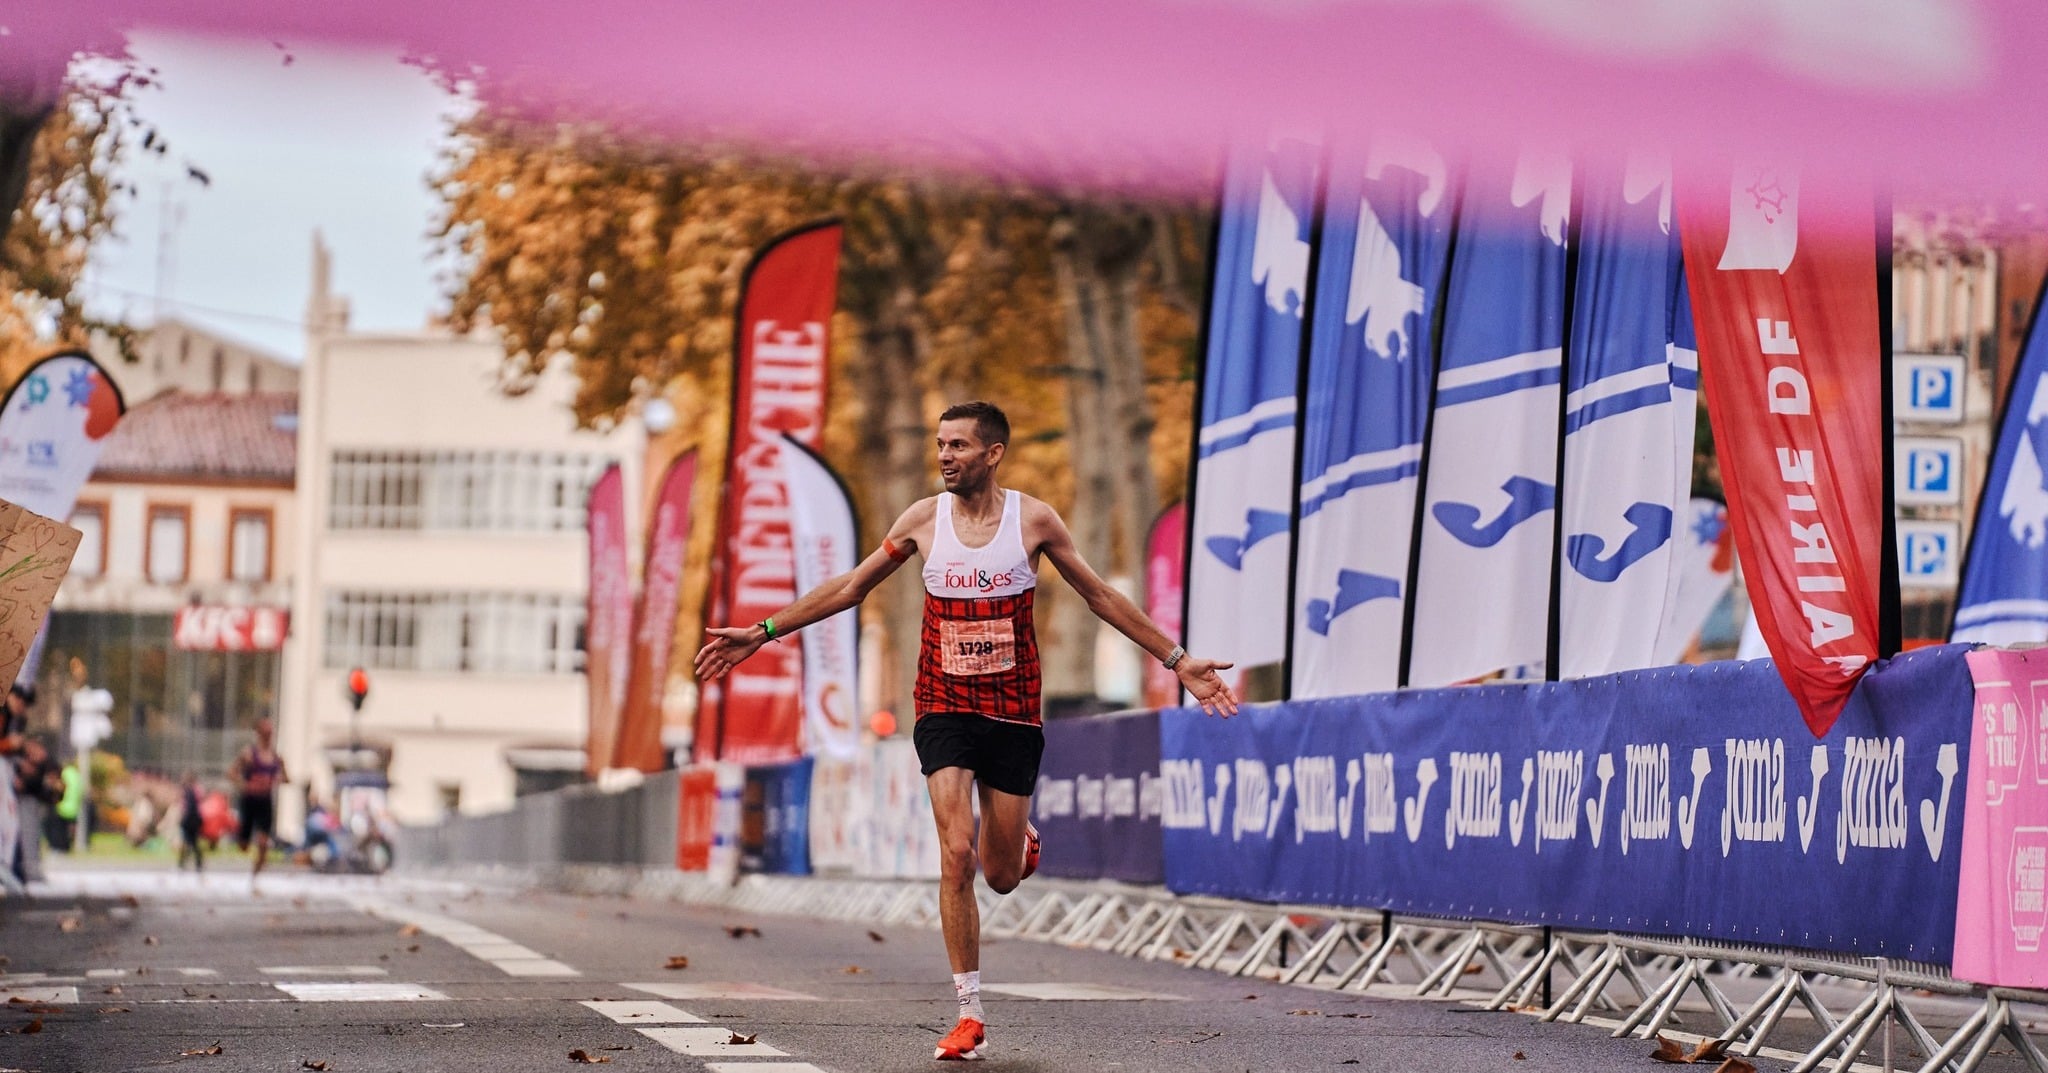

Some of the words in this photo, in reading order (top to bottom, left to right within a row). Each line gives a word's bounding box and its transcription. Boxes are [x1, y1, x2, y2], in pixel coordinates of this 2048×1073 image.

[944, 568, 1013, 590] foul&es
[174, 606, 248, 649] KFC
[958, 640, 994, 657] 1728
